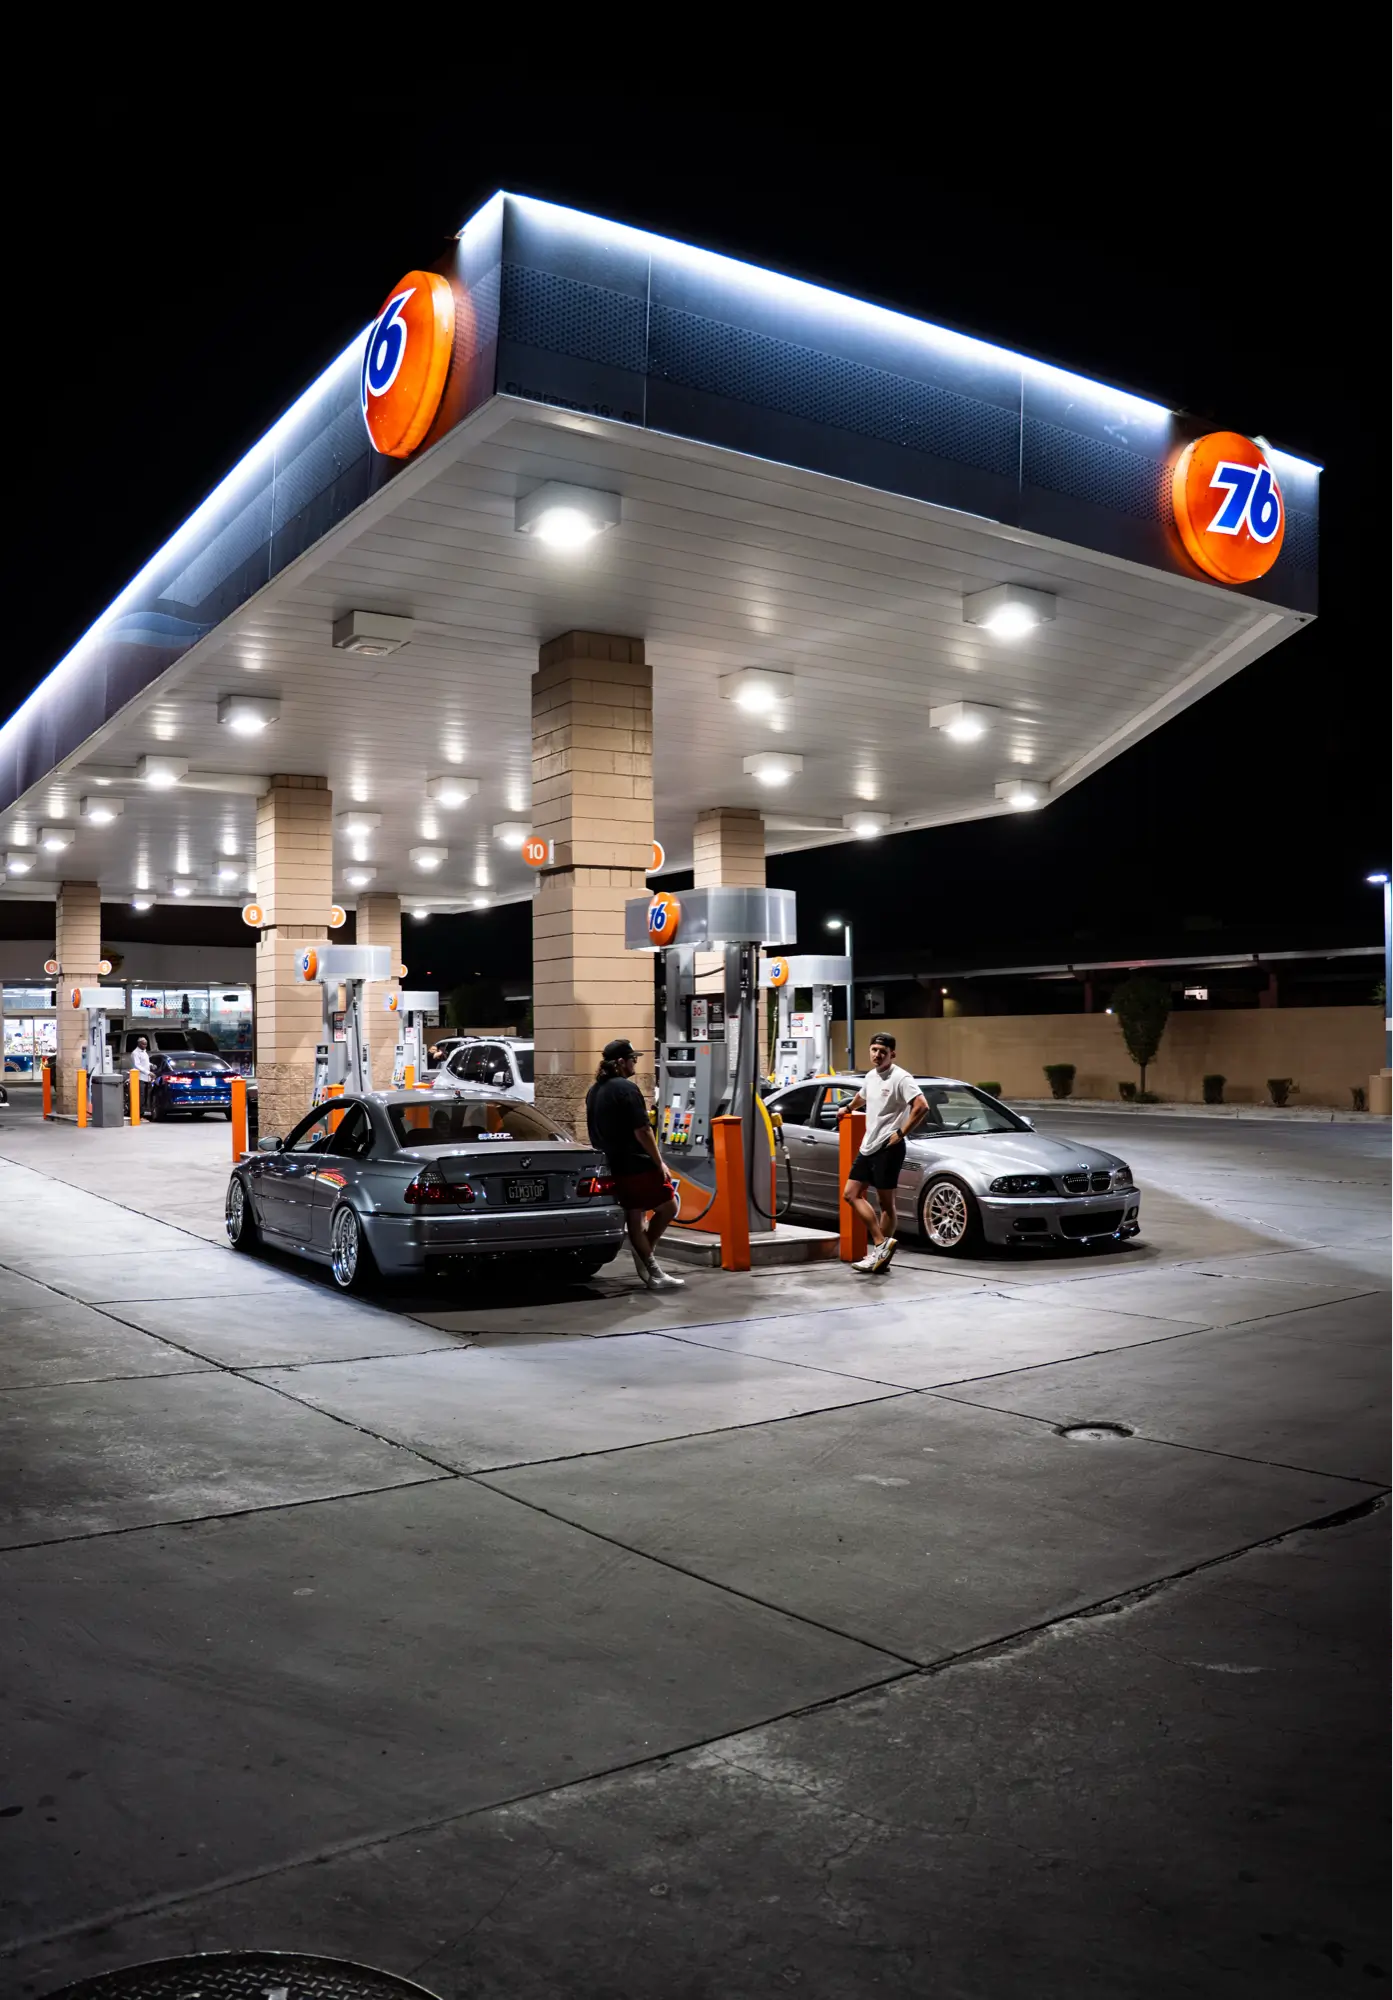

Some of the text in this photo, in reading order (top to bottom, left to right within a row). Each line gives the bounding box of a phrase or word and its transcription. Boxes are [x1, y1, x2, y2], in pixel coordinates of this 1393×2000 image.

[505, 381, 588, 413] Clearance
[1208, 461, 1280, 544] 76
[526, 843, 544, 860] 10
[249, 909, 258, 920] 8
[332, 911, 340, 922] 7
